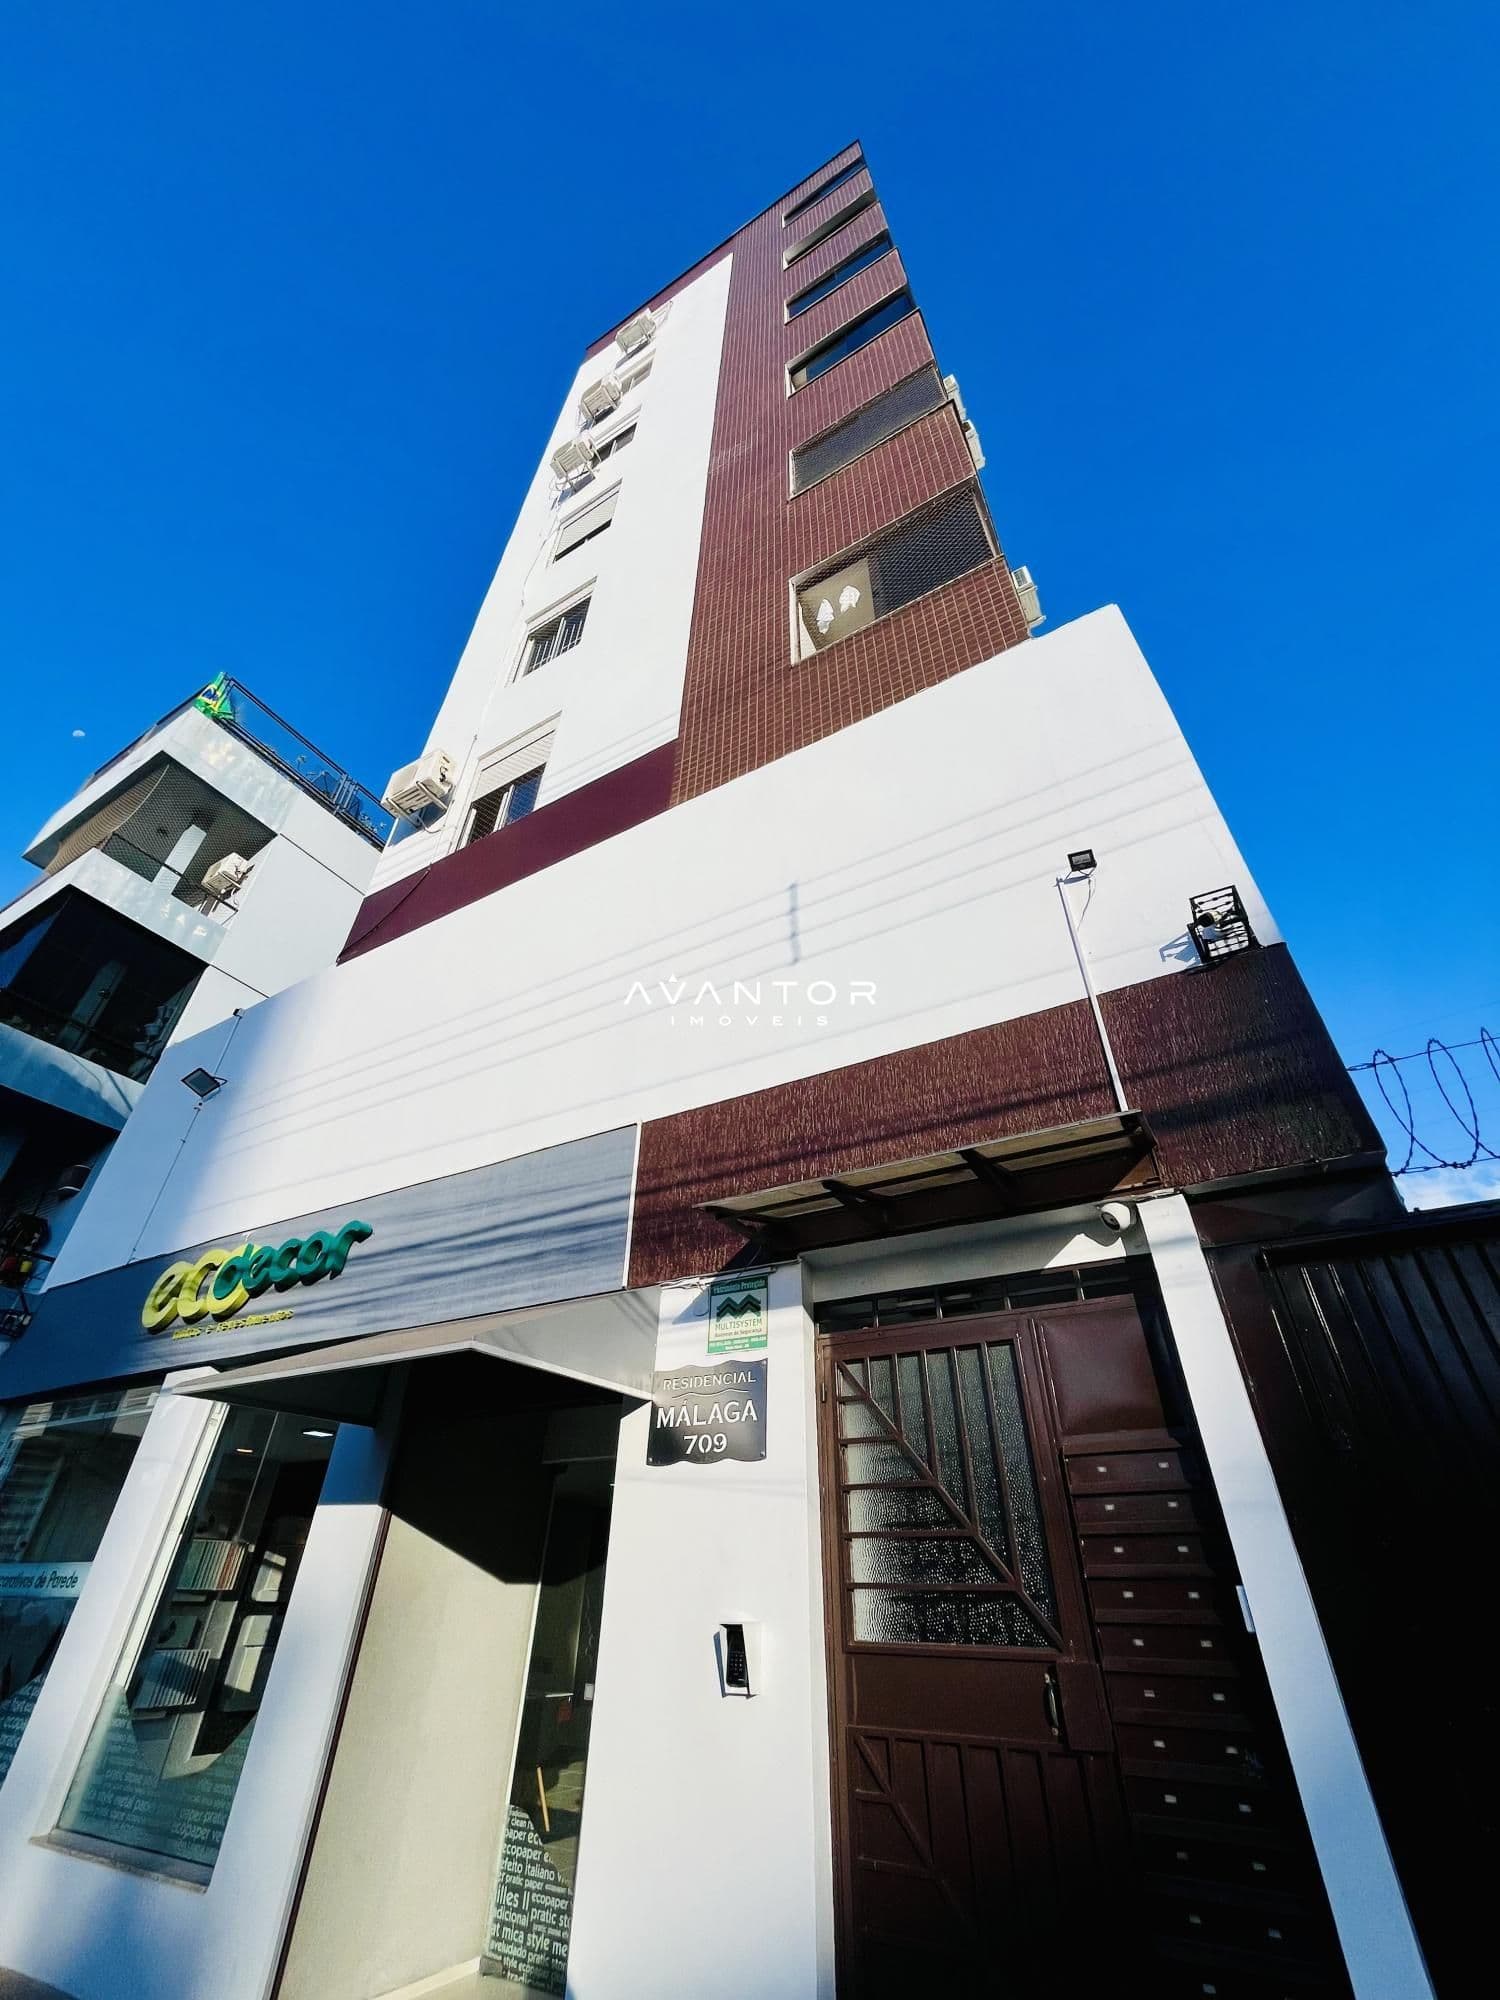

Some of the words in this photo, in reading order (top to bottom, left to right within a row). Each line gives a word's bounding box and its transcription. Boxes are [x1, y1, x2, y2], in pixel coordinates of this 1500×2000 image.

[715, 1318, 762, 1331] MULTISYSTEM
[663, 1370, 757, 1391] RESIDENCIAL
[656, 1399, 758, 1429] MÁLAGA
[683, 1433, 727, 1455] 709
[48, 1570, 79, 1589] Parede
[524, 1879, 544, 1892] paper
[531, 1892, 569, 1911] ecopaper
[530, 1907, 557, 1925] pratic
[501, 1924, 525, 1945] mica
[526, 1932, 550, 1953] style
